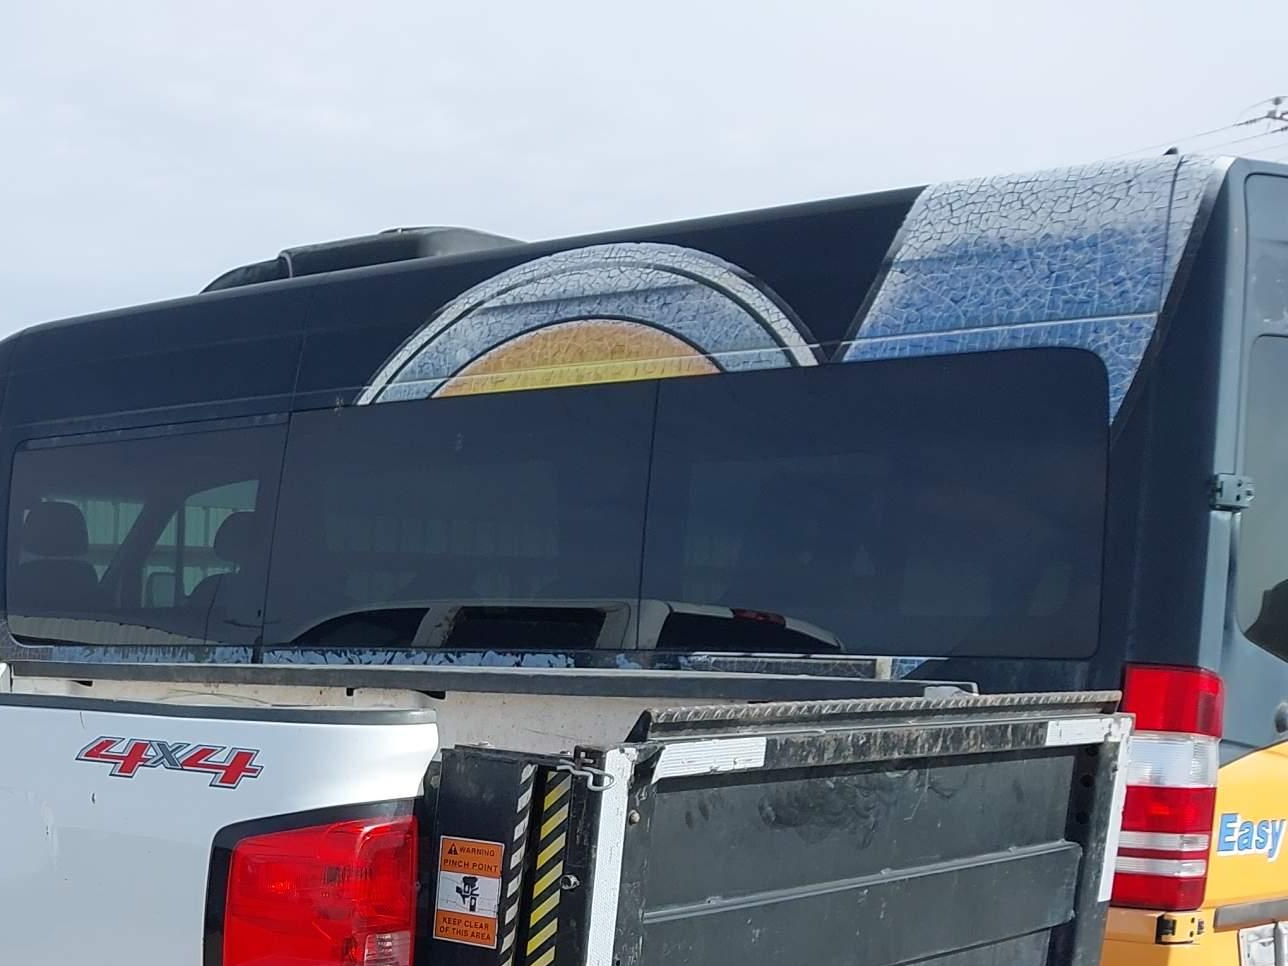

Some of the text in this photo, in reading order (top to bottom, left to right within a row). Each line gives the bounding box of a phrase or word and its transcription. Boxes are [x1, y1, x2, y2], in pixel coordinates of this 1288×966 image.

[1217, 812, 1286, 861] Easy
[459, 847, 495, 857] WARNING
[443, 858, 499, 873] PINCH POINT
[442, 916, 489, 931] KEEP CLEAR
[439, 925, 491, 941] OF THIS AREA
